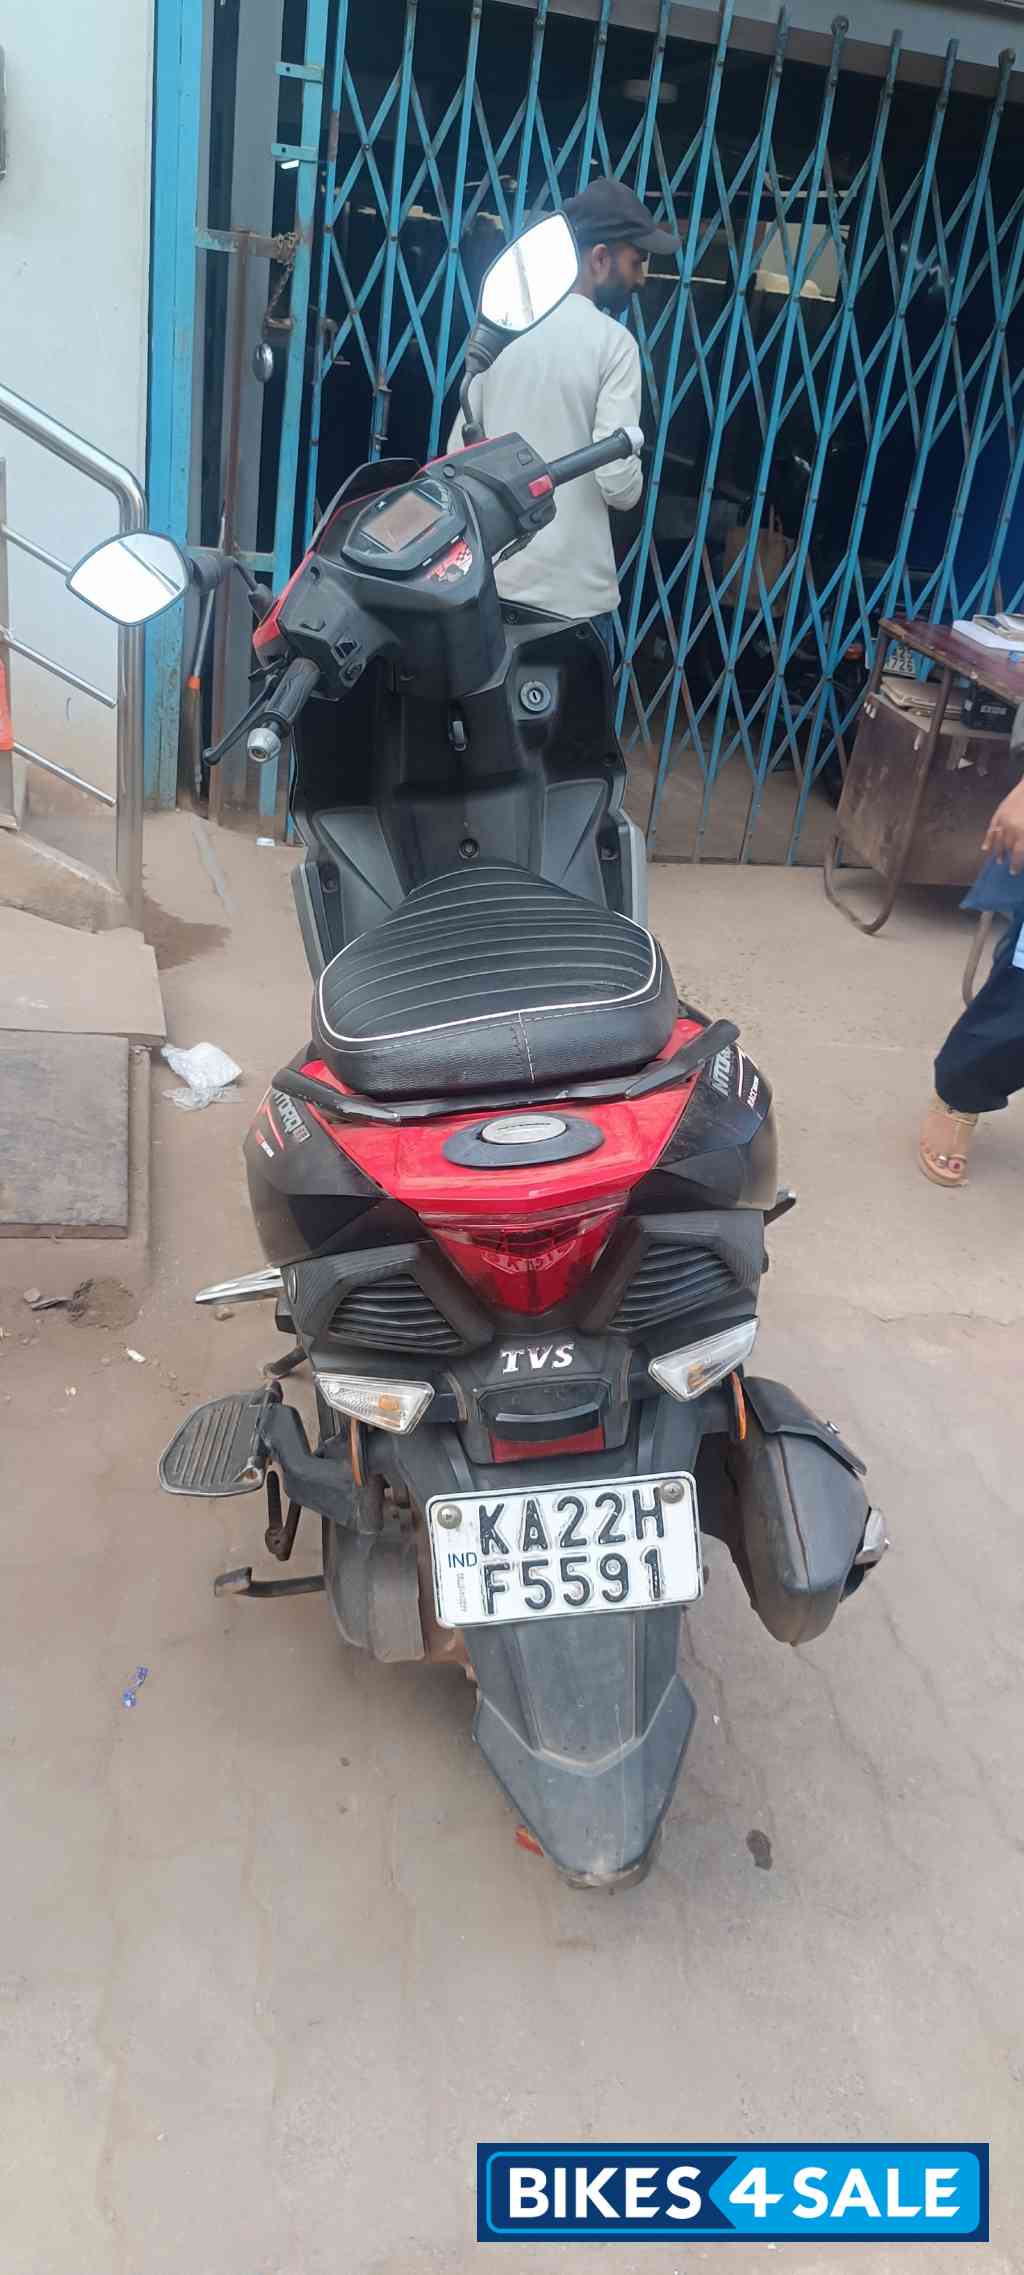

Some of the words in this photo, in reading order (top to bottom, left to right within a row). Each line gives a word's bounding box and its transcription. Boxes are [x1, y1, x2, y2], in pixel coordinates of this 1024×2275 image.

[501, 1342, 575, 1375] TVS
[479, 1487, 665, 1555] KA22H
[448, 1551, 478, 1568] IND
[484, 1549, 661, 1614] F5591
